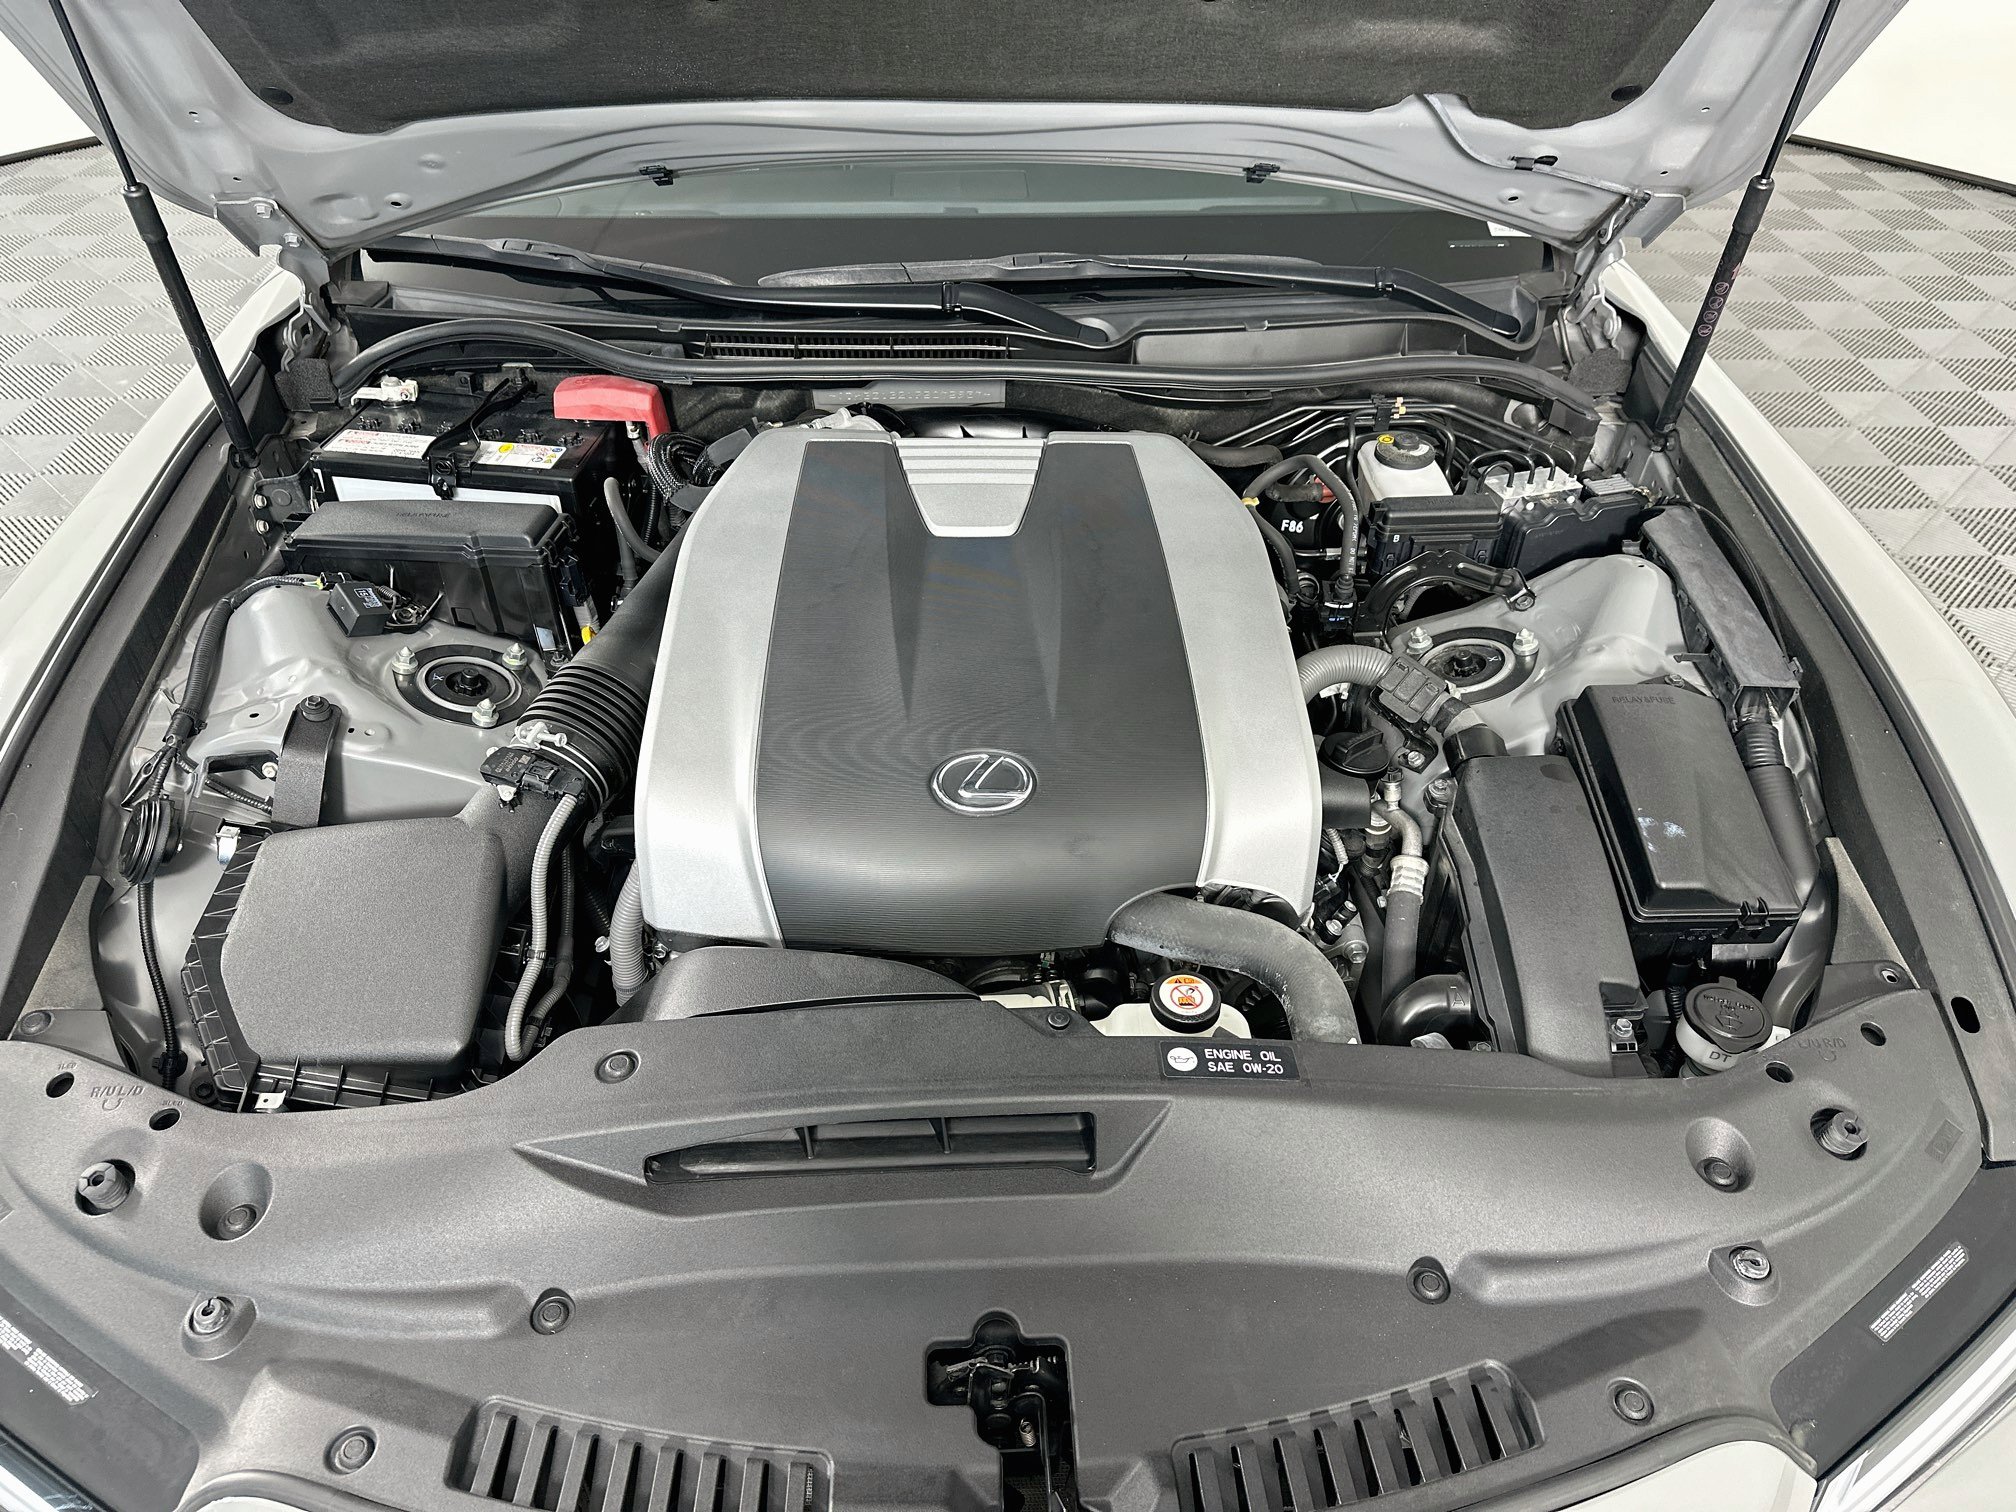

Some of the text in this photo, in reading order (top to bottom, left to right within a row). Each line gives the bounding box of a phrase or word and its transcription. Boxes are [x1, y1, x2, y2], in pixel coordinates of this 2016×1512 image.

[1280, 519, 1304, 533] F86
[1392, 534, 1400, 543] B
[1204, 1048, 1282, 1062] ENGINE OIL
[1708, 1051, 1732, 1063] DT
[1208, 1061, 1284, 1075] SAE 0W-20
